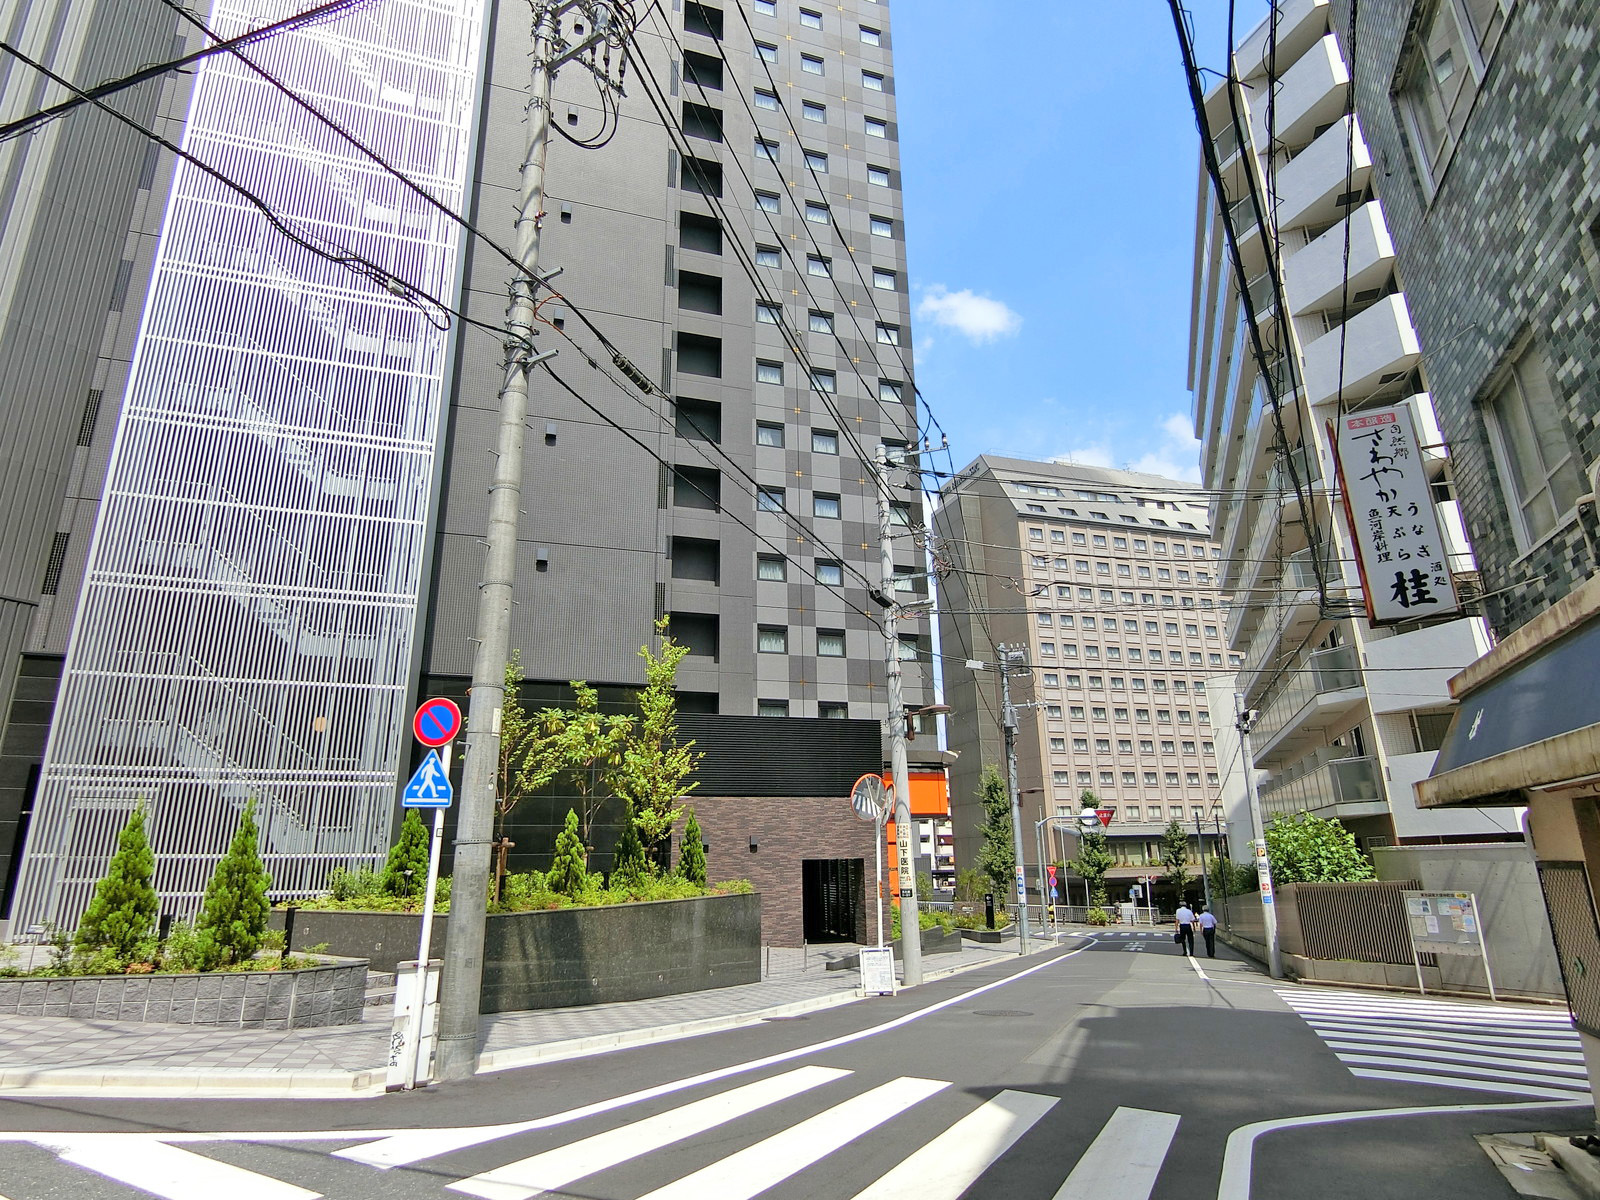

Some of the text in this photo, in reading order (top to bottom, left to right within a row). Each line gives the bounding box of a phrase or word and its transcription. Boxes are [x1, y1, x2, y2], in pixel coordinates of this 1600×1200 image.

[1351, 414, 1393, 428] 本醸造
[1390, 424, 1409, 459] 自然郷
[1351, 428, 1404, 503] さわやか
[1367, 508, 1393, 563] 魚河岸料理
[1387, 505, 1411, 561] 天ぷら
[1408, 502, 1430, 558] うなぎ
[1390, 568, 1438, 608] 桂
[1431, 561, 1447, 586] 酒処
[899, 839, 909, 875] 山下医院
